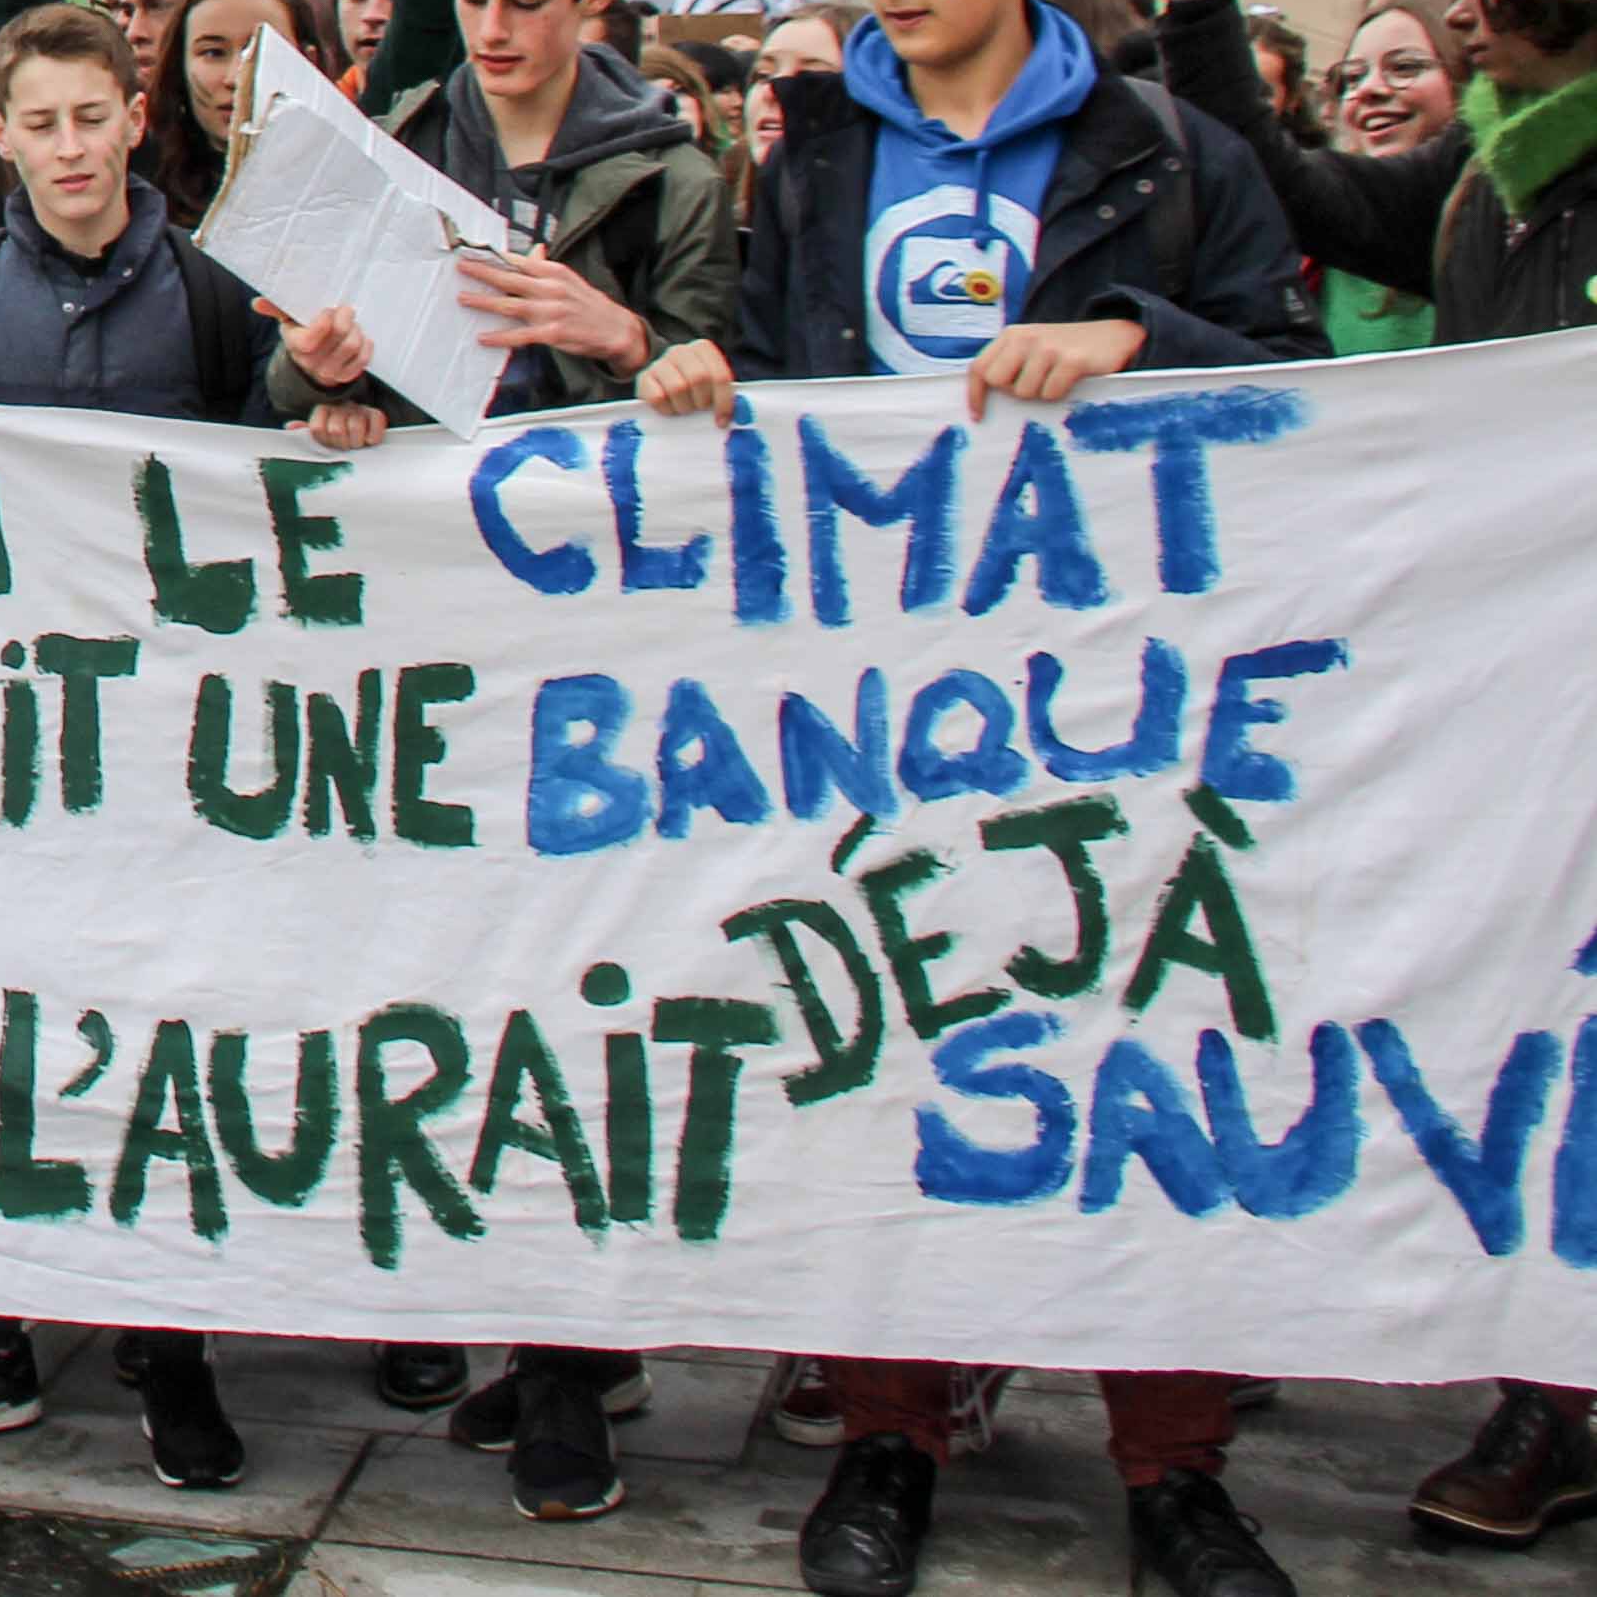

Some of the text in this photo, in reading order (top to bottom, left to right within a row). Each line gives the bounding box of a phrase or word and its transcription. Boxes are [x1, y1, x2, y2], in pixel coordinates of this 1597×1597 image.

[132, 451, 365, 635] LE
[468, 383, 1311, 629] CLIMAT
[188, 661, 481, 849] UNE
[526, 635, 1349, 858] BANQUE
[720, 781, 1282, 1111] DÉJÀ
